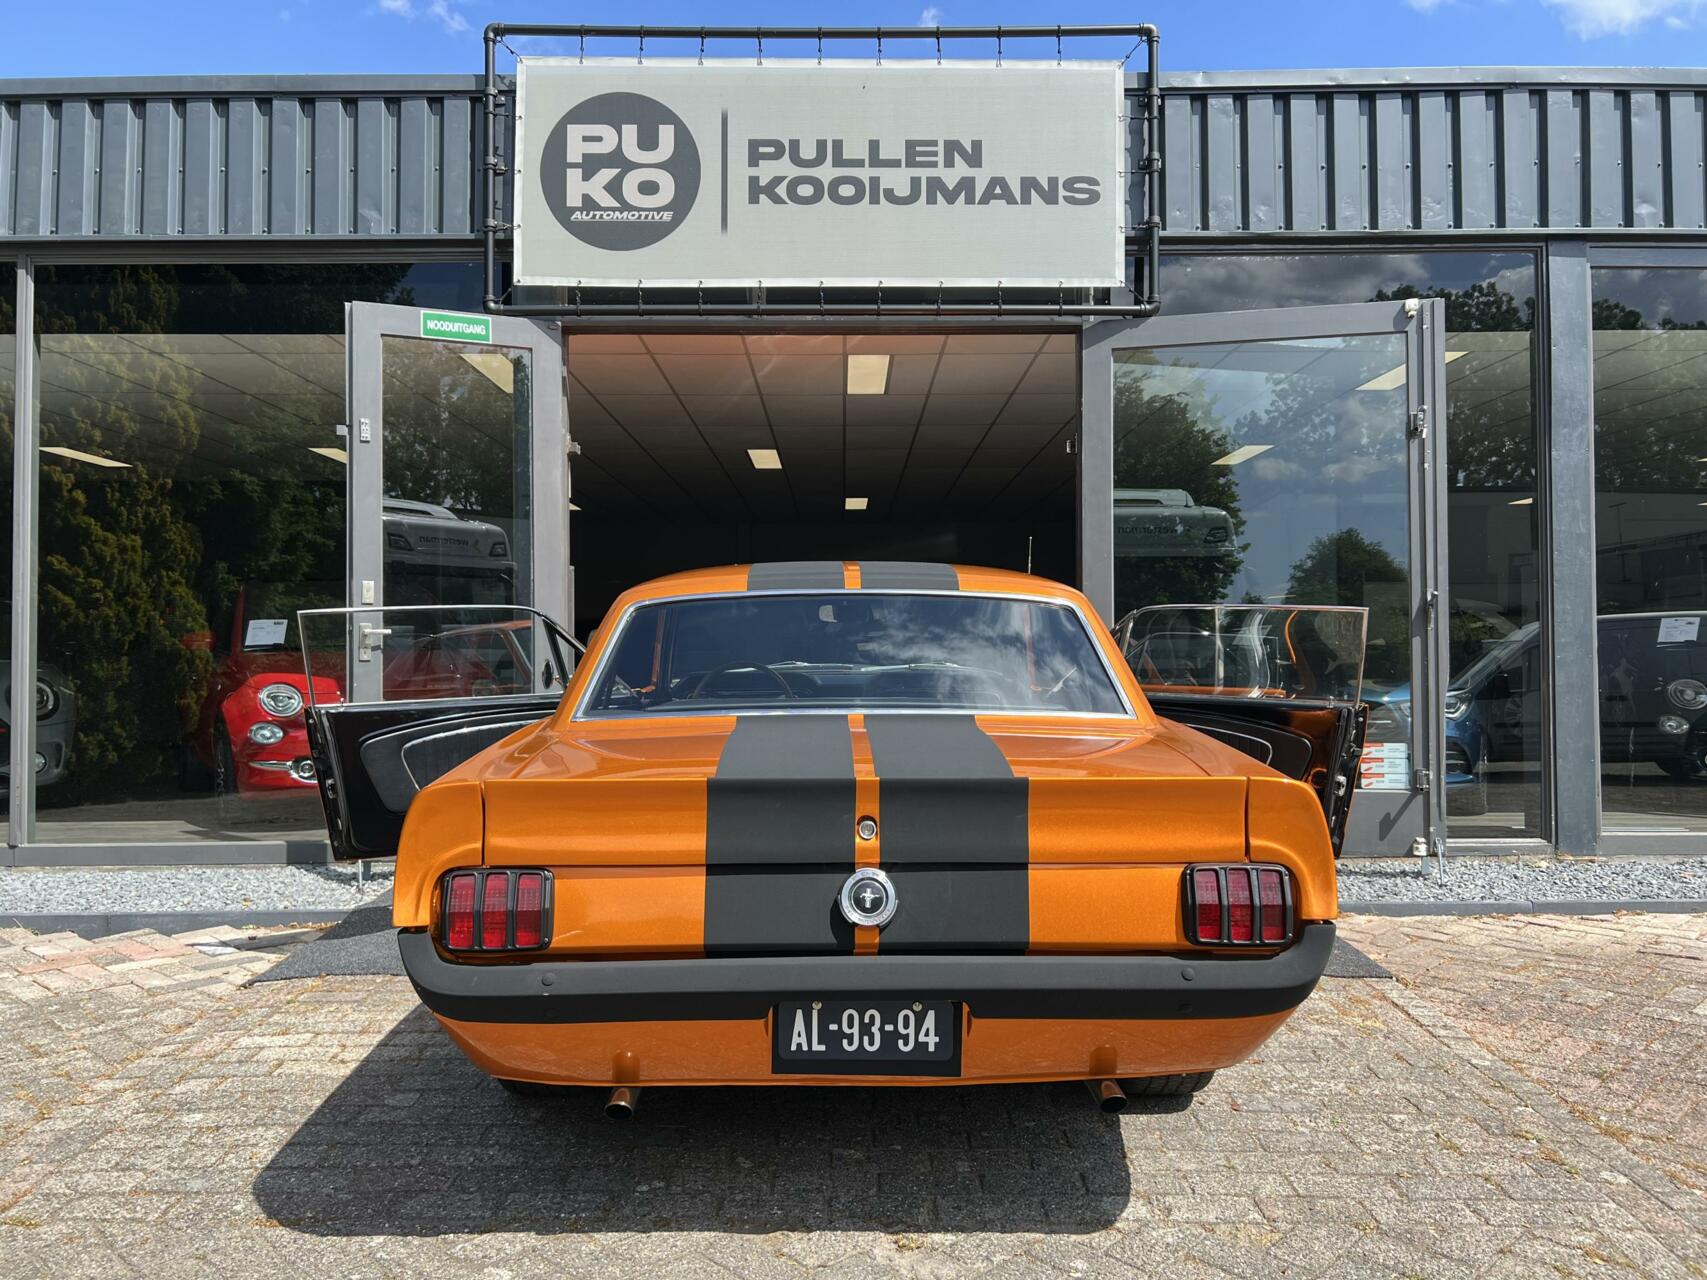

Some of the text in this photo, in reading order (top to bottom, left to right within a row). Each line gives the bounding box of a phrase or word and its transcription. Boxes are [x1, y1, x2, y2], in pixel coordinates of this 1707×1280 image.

[566, 124, 675, 164] PU
[748, 138, 983, 169] PULLEN
[566, 167, 675, 209] KO
[748, 175, 1101, 206] KOOIJMANS
[570, 210, 675, 222] AUTOMOTIVE
[426, 319, 487, 336] NOODUITGANG
[790, 1008, 940, 1052] AL-93-94
